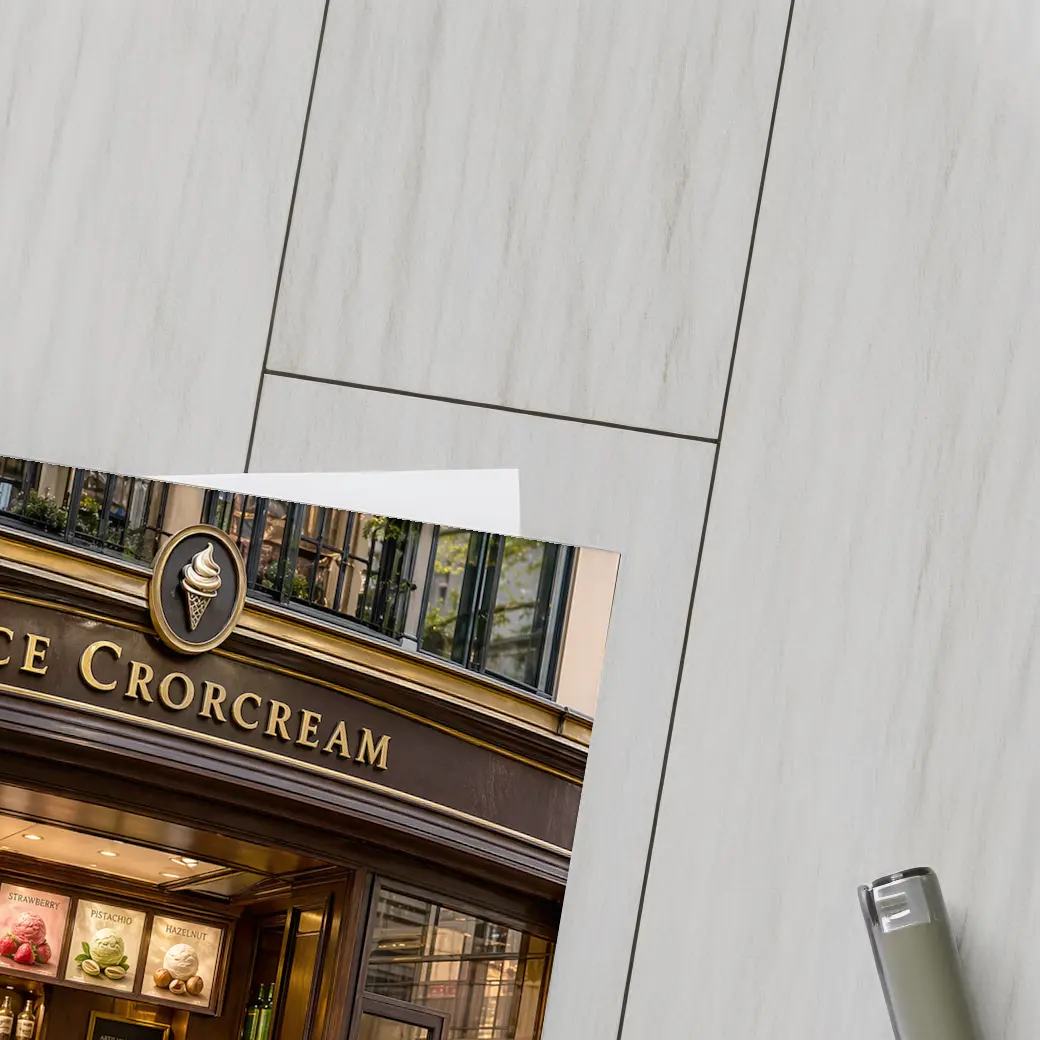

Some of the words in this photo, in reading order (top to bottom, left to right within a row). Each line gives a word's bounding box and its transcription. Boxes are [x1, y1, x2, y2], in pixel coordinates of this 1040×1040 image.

[78, 640, 392, 772] CRORCREAM
[8, 892, 60, 910] STRAWBERRY
[90, 909, 133, 925] PISTACHIO
[165, 924, 208, 941] HAZELNUT
